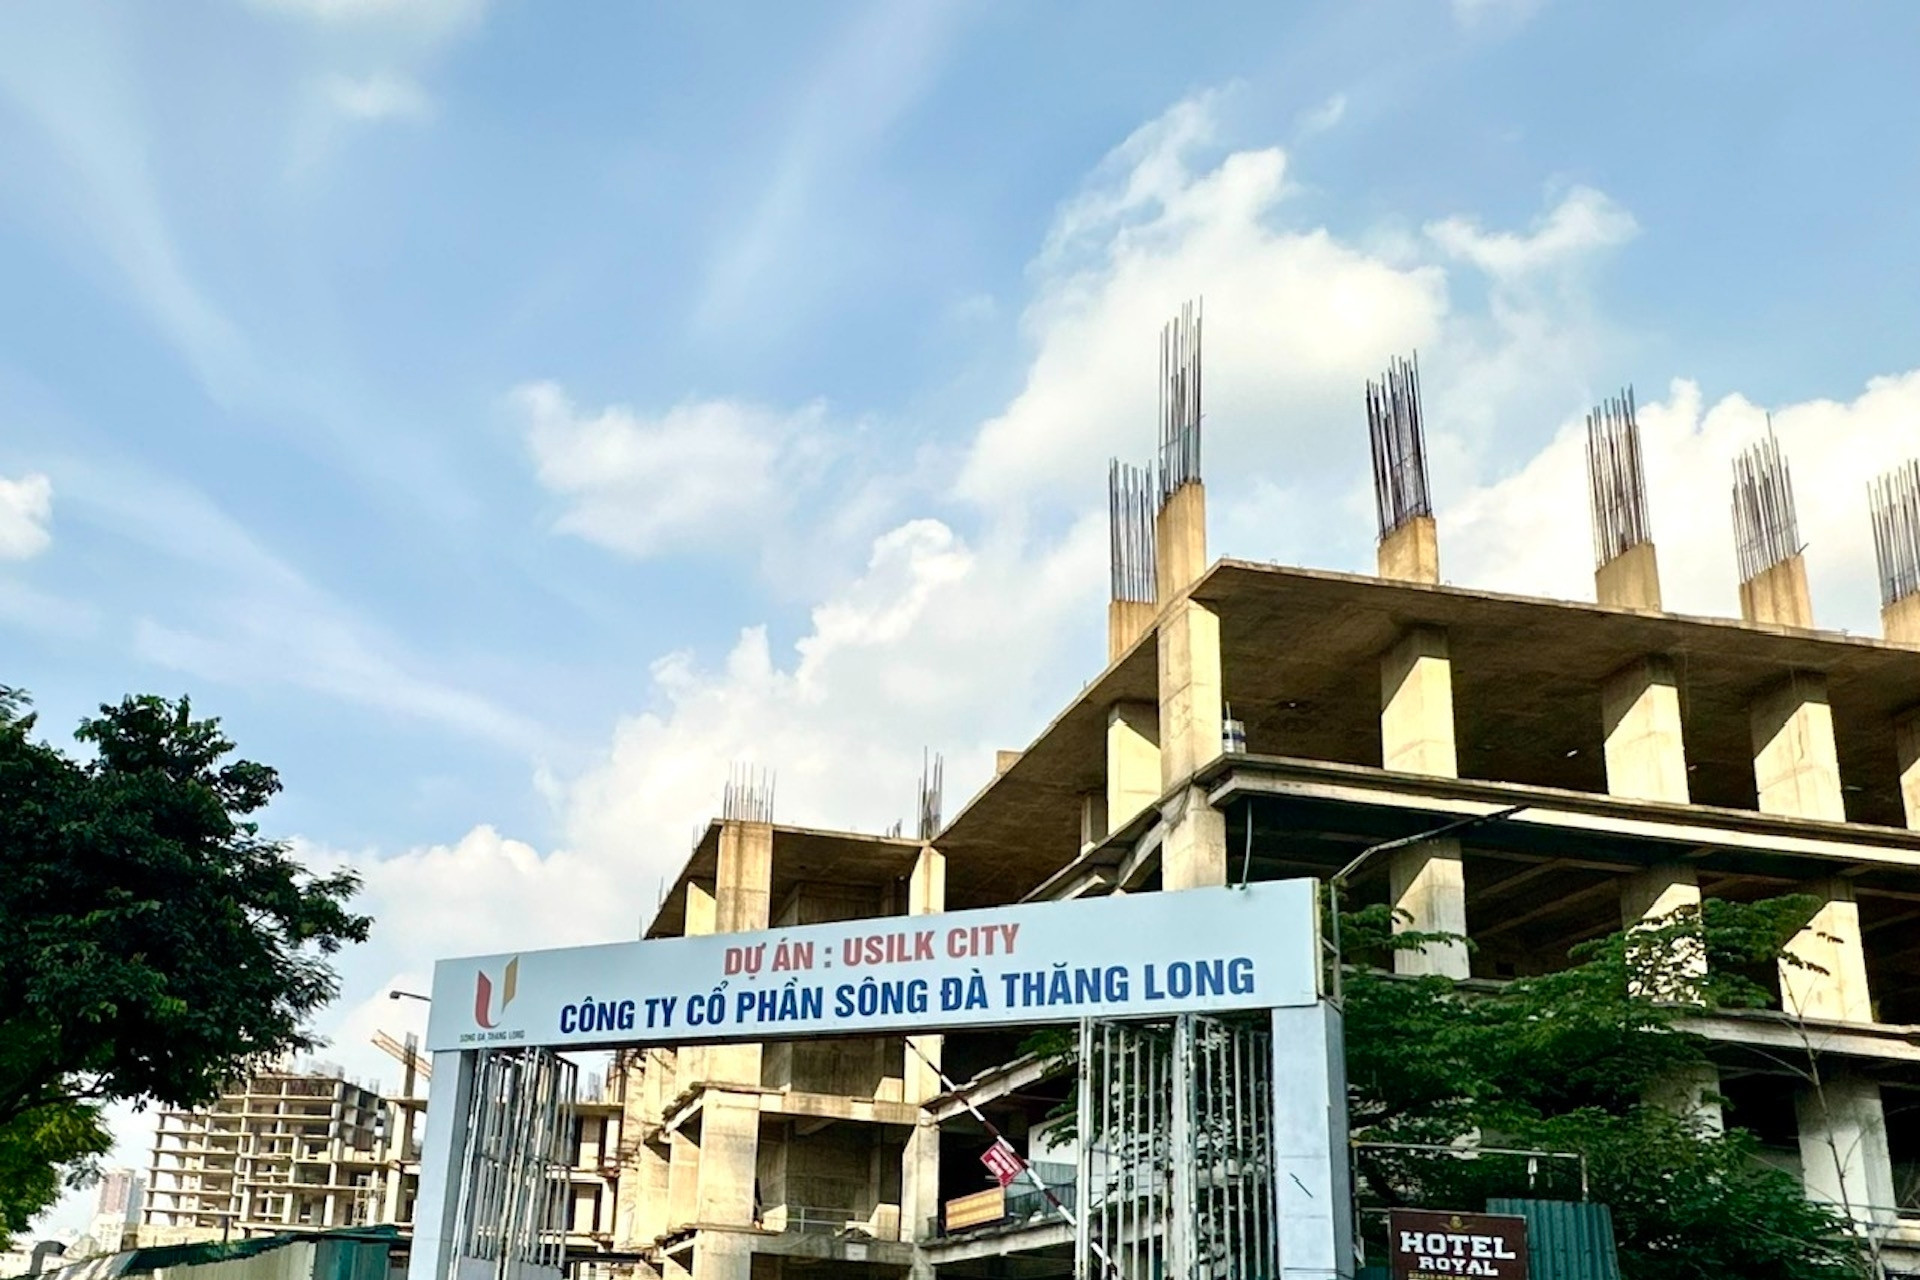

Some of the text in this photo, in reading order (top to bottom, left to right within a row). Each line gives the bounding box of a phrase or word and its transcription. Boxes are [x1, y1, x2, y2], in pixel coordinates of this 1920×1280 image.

[724, 942, 767, 980] DỰ
[771, 937, 814, 972] ÁN
[842, 930, 936, 968] USILK
[946, 923, 1020, 960] CITY
[560, 957, 1255, 1034] CÔNG TY CỔ PHẦN SÔNG ĐÀ THĂNG LONG
[1400, 1231, 1516, 1259] HOTEL
[1419, 1256, 1498, 1276] ROYAL
